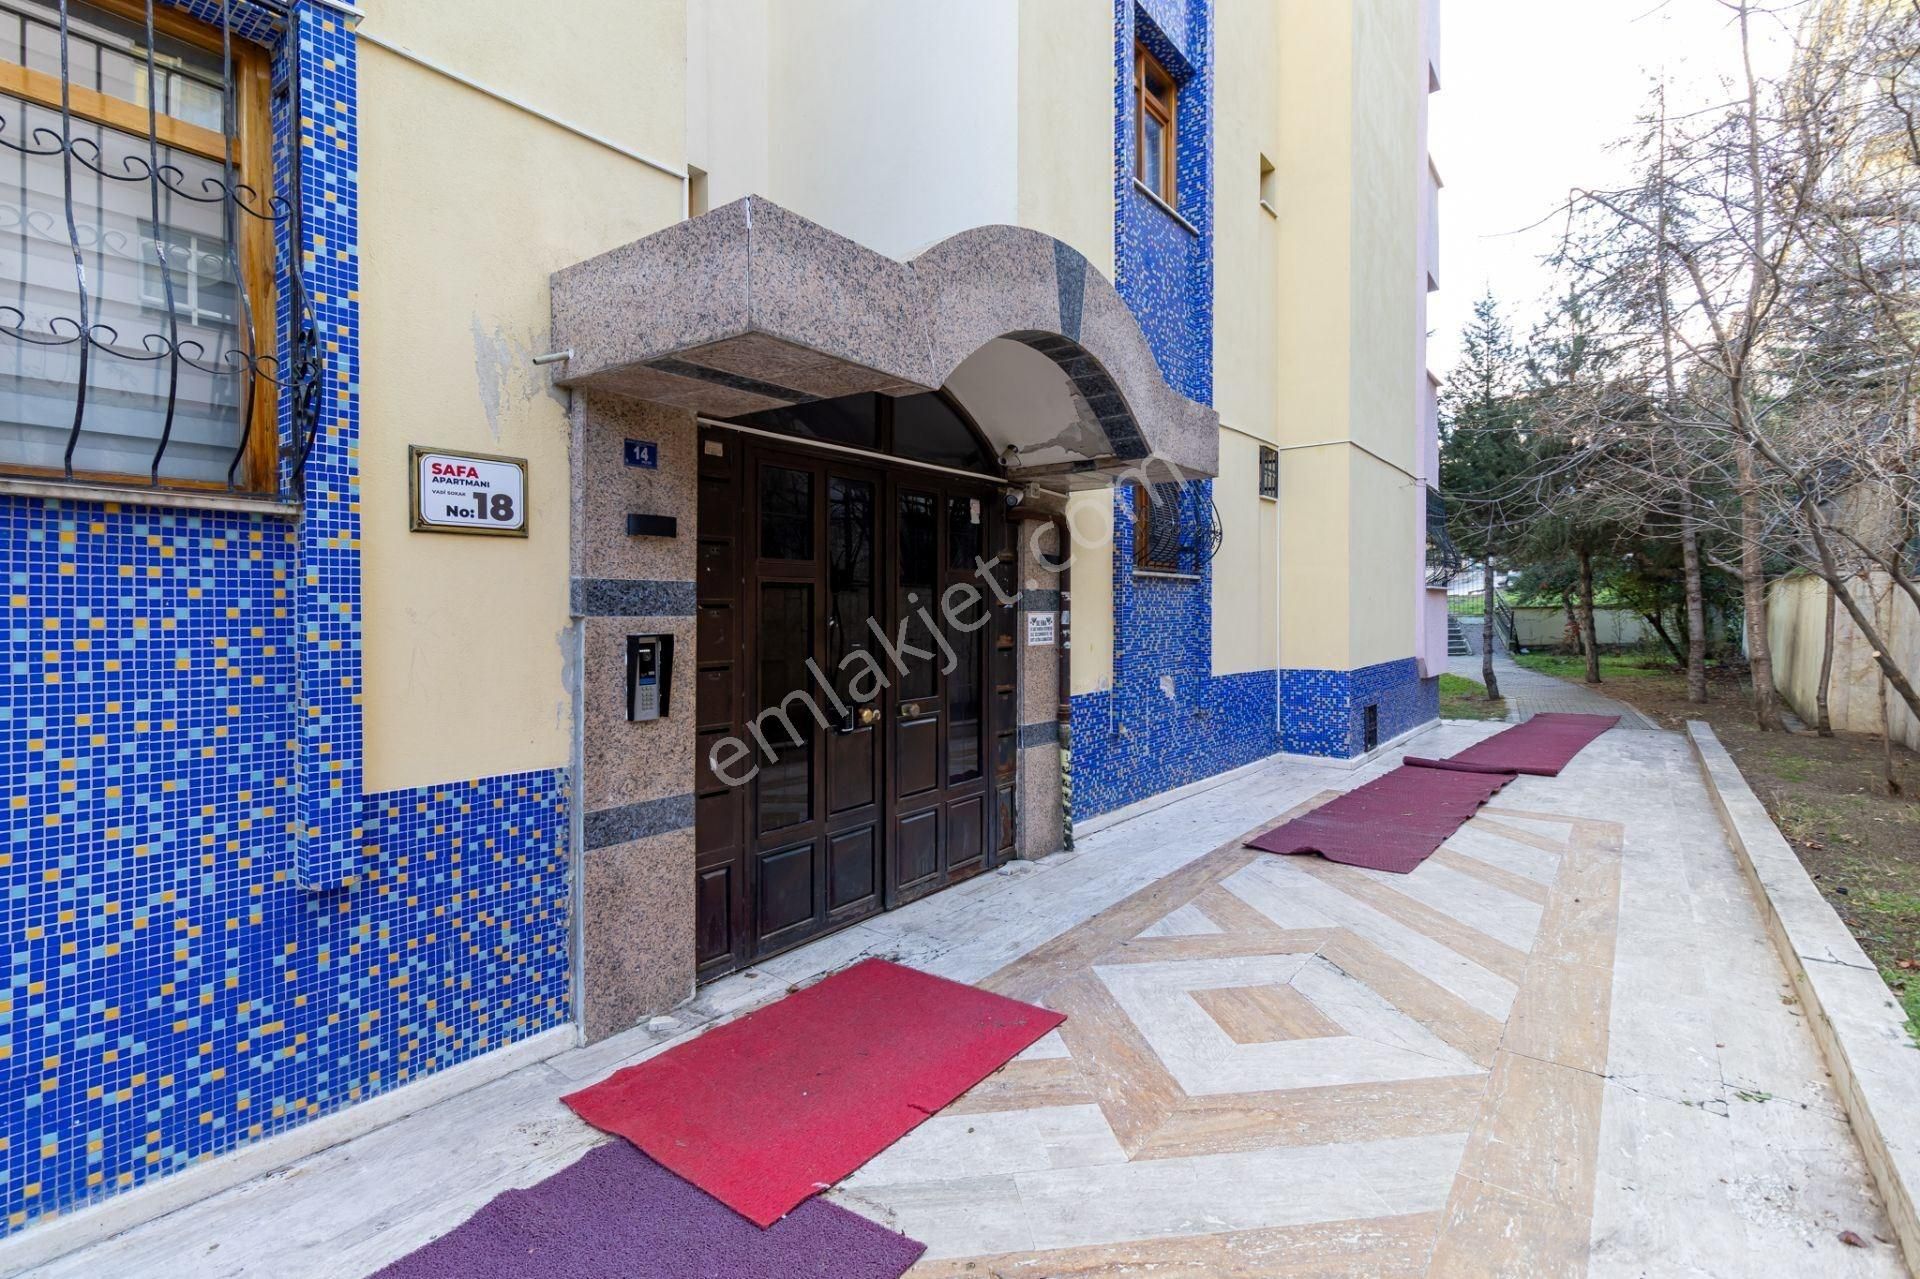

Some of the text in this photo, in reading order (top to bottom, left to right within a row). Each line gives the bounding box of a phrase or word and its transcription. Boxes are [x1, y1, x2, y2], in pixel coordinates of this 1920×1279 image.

[633, 446, 649, 461] 14
[431, 463, 479, 479] SAFA
[432, 476, 490, 488] APARTMANI
